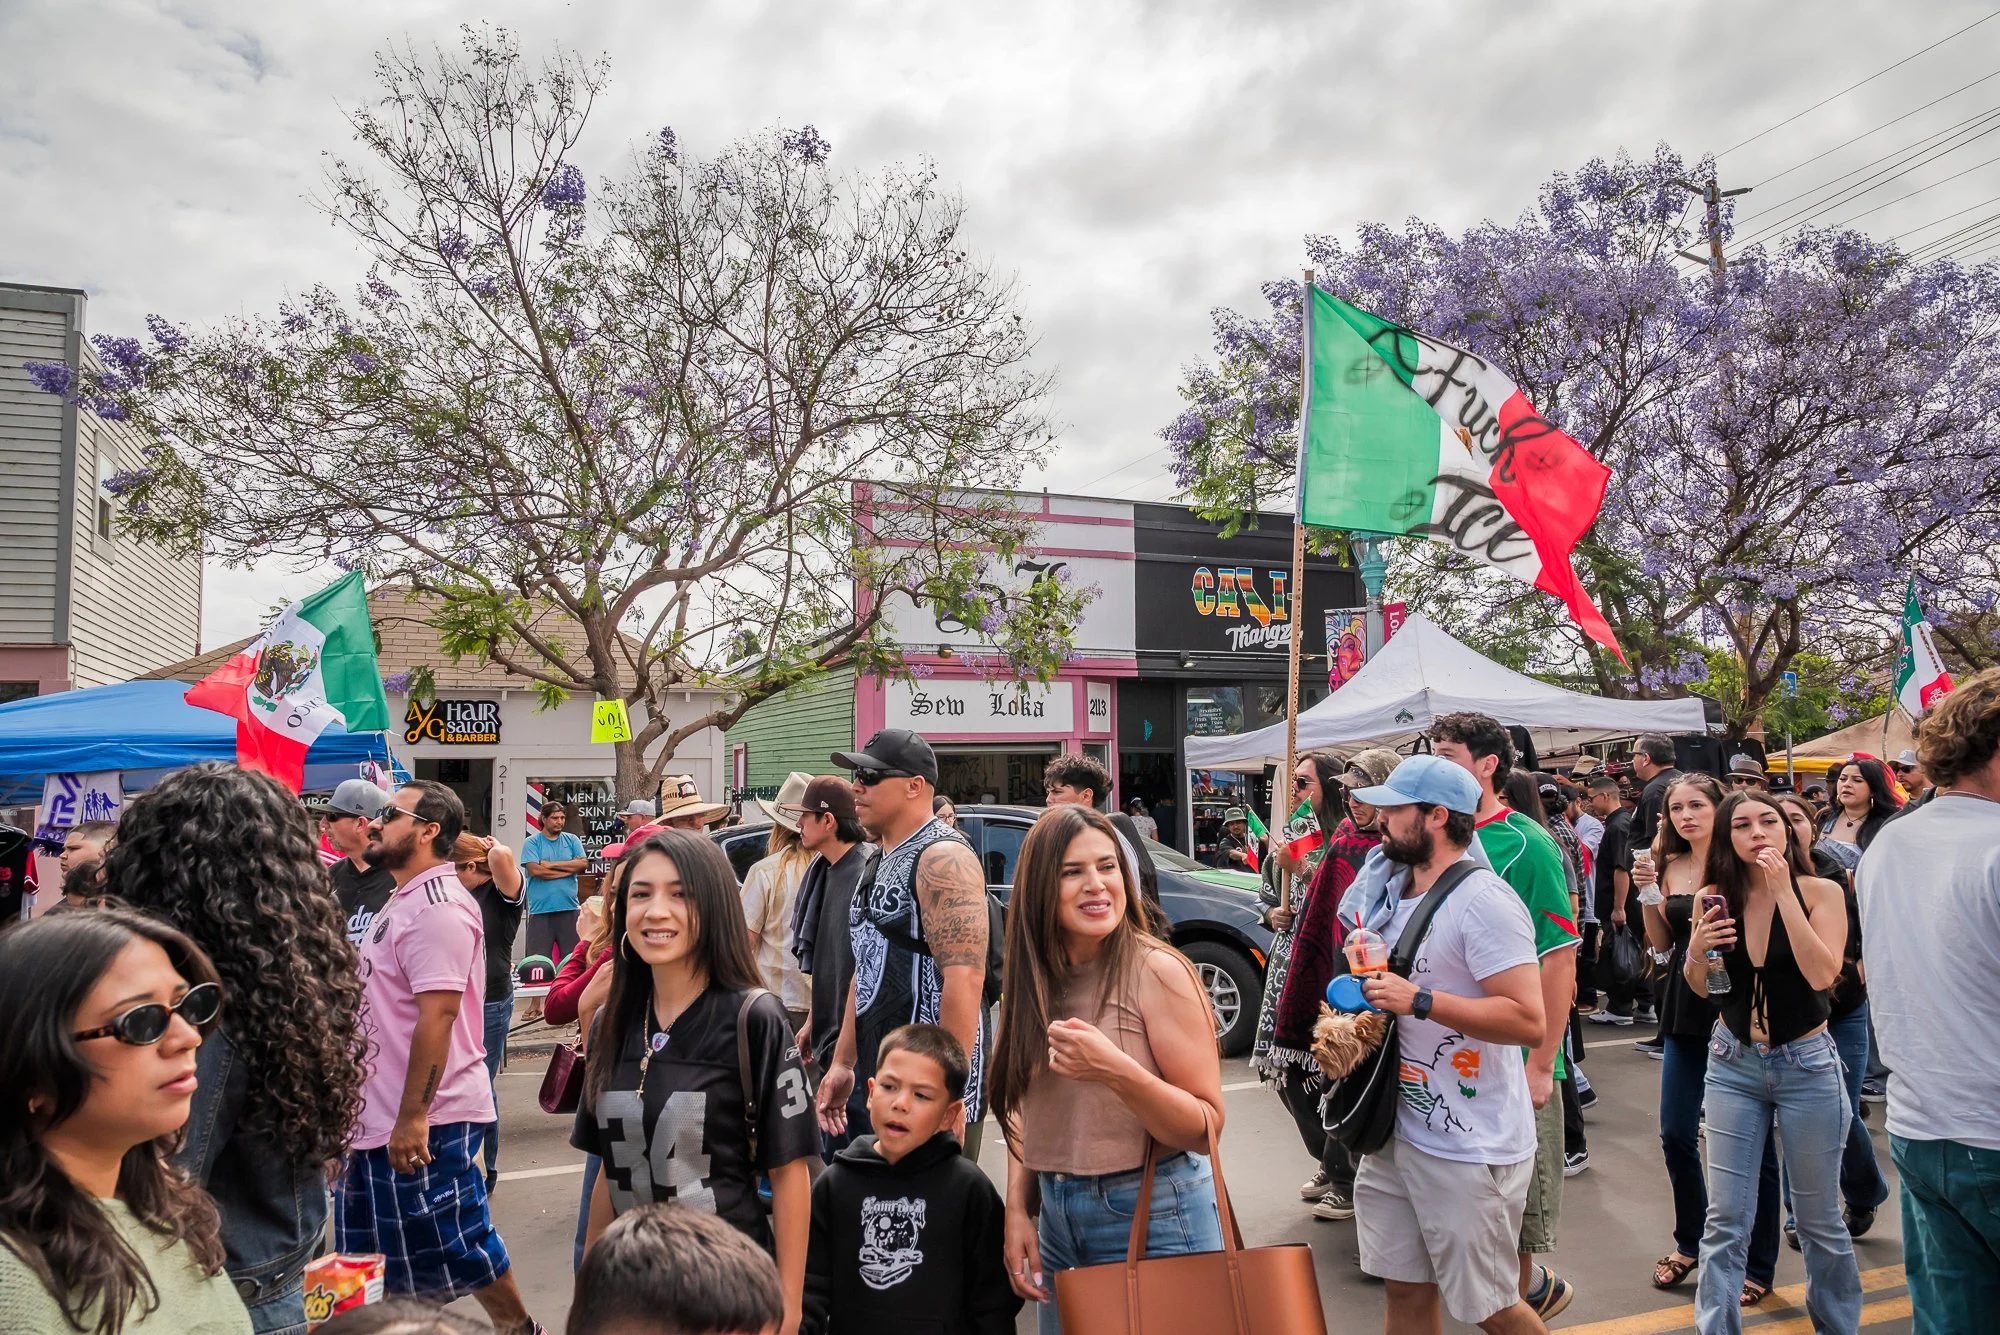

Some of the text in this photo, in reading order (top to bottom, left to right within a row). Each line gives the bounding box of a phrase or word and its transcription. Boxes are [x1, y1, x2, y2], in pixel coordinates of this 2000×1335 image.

[1367, 328, 1558, 483] Fuck
[1406, 473, 1533, 563] Ice
[909, 692, 1045, 718] Sew Loka
[1089, 697, 1108, 717] 2113
[456, 734, 497, 742] BARBER
[498, 765, 507, 826] 2115
[567, 793, 617, 803] MEN HA
[578, 806, 605, 817] SKIN
[590, 821, 616, 831] TAP
[581, 835, 612, 845] EARD
[596, 1090, 716, 1216] 34
